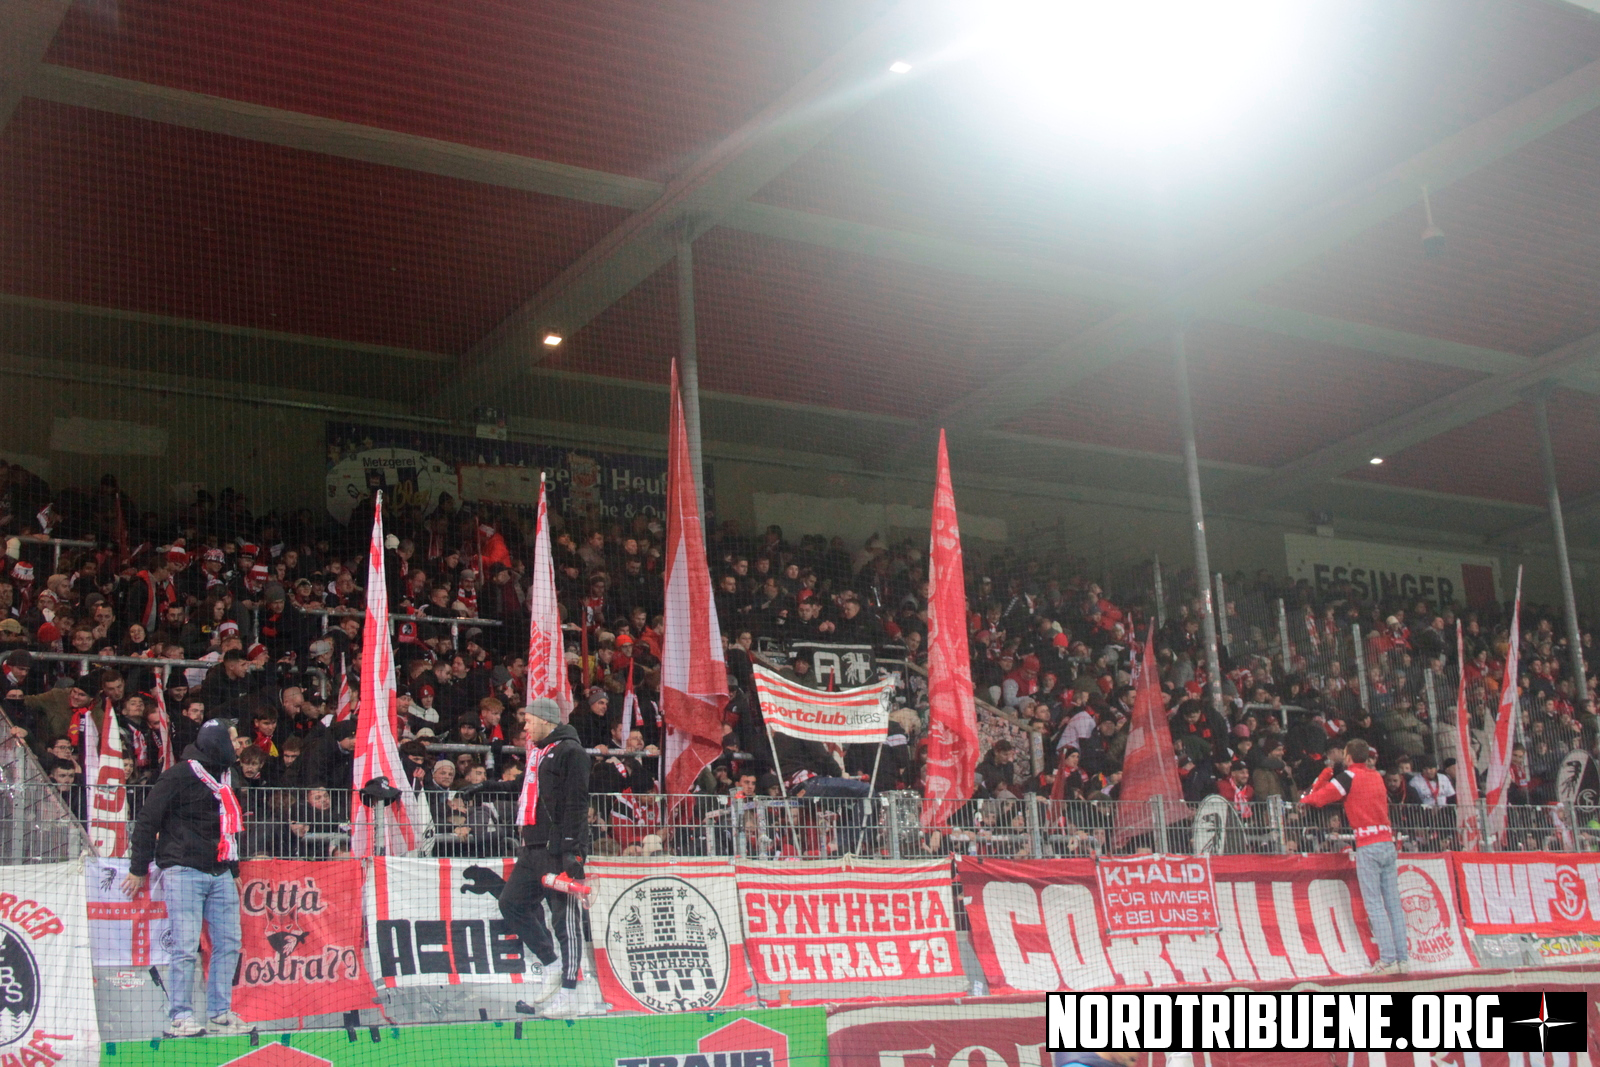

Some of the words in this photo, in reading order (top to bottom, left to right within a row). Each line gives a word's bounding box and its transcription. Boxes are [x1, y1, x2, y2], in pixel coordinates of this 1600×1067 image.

[363, 455, 416, 468] Metzgerei
[1103, 863, 1206, 886] KHALID
[243, 879, 325, 913] Città
[1108, 888, 1146, 907] FÜR
[1150, 890, 1211, 905] IMMER
[744, 890, 950, 934] SYNTHESIA
[1126, 909, 1155, 925] BEI
[1160, 908, 1199, 923] UNS
[1415, 930, 1455, 954] JAHRE
[629, 958, 711, 971] SYNTHESIA
[759, 940, 902, 982] ULTRAS
[909, 937, 953, 974] 79
